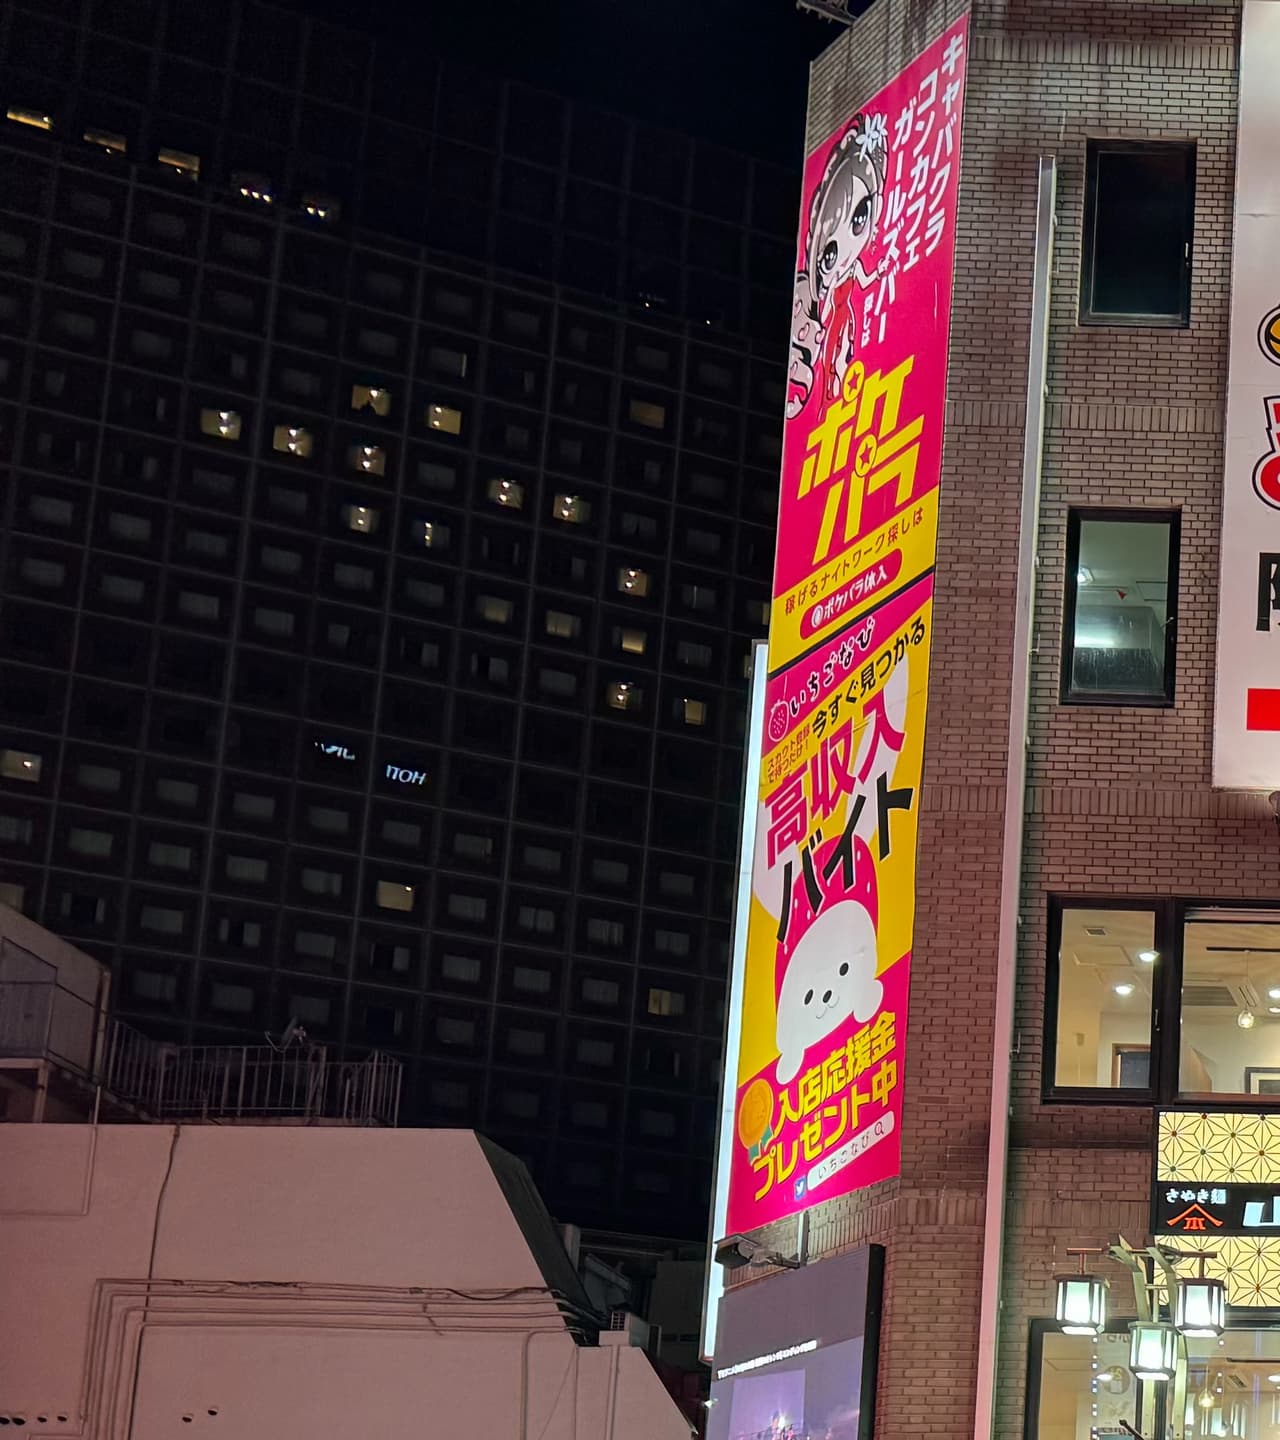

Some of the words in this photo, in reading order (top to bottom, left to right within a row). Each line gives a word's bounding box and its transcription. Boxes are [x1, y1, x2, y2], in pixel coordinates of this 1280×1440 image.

[876, 98, 916, 344] ガールズバー
[902, 65, 937, 274] コンカフェ
[925, 34, 963, 257] キャバクラ
[812, 615, 925, 738] 今すぐ見つかる
[765, 697, 905, 872] 高収入
[777, 769, 914, 944] バイト
[754, 1058, 898, 1201] プレゼント中
[773, 1012, 898, 1132] 入店応援金
